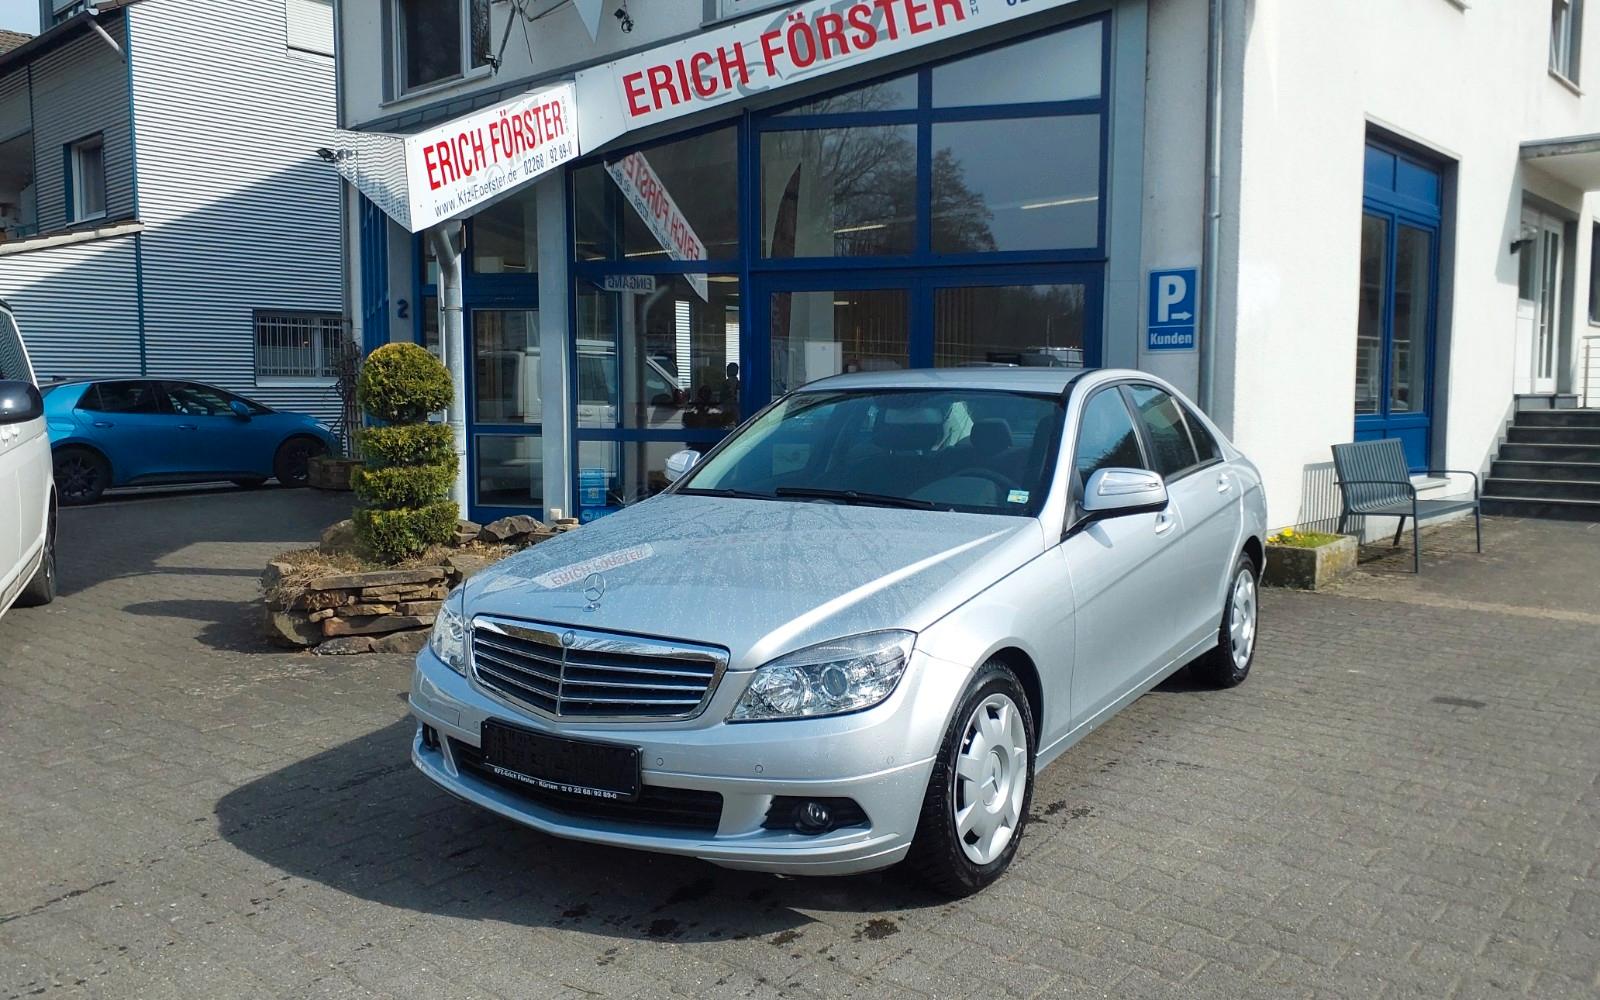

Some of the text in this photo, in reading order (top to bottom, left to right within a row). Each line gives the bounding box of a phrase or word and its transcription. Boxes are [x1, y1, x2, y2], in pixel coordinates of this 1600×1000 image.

[622, 42, 750, 117] ERICH
[760, 0, 966, 76] FÖRSTER
[423, 127, 487, 191] ERICH
[489, 100, 565, 164] FÖRSTER
[434, 168, 518, 217] www.Kfz-Foerster.de
[396, 298, 409, 318] 2
[1157, 275, 1187, 322] P
[1150, 332, 1192, 345] Kunden
